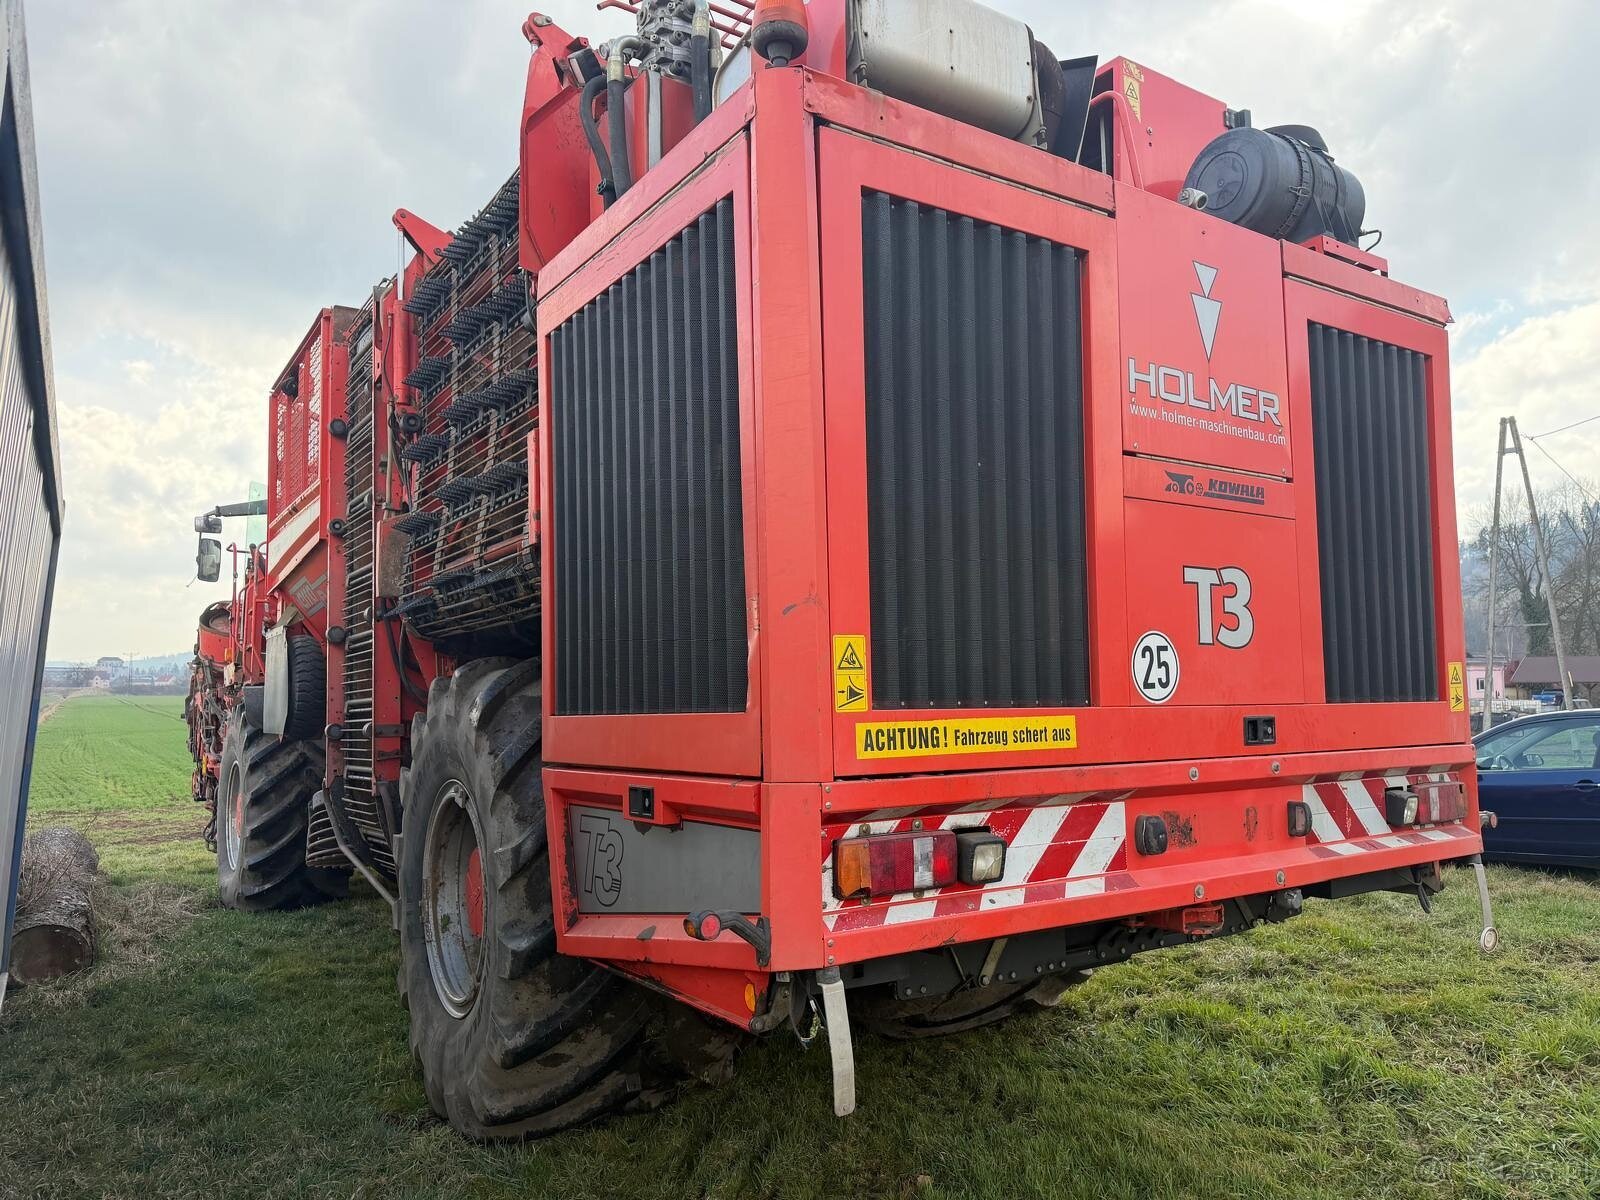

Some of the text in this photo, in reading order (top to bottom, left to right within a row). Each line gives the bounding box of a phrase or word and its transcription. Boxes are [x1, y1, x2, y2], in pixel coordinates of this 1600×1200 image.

[1128, 358, 1282, 425] HOLMER
[1130, 403, 1286, 446] www.holmer-maschinenbau.com
[1208, 478, 1264, 498] KOWALA
[1183, 565, 1254, 649] T3
[1141, 645, 1170, 689] 25
[954, 729, 1008, 747] Fahrzeug
[1013, 727, 1048, 744] schert
[1052, 727, 1071, 742] aus
[580, 815, 624, 907] T3
